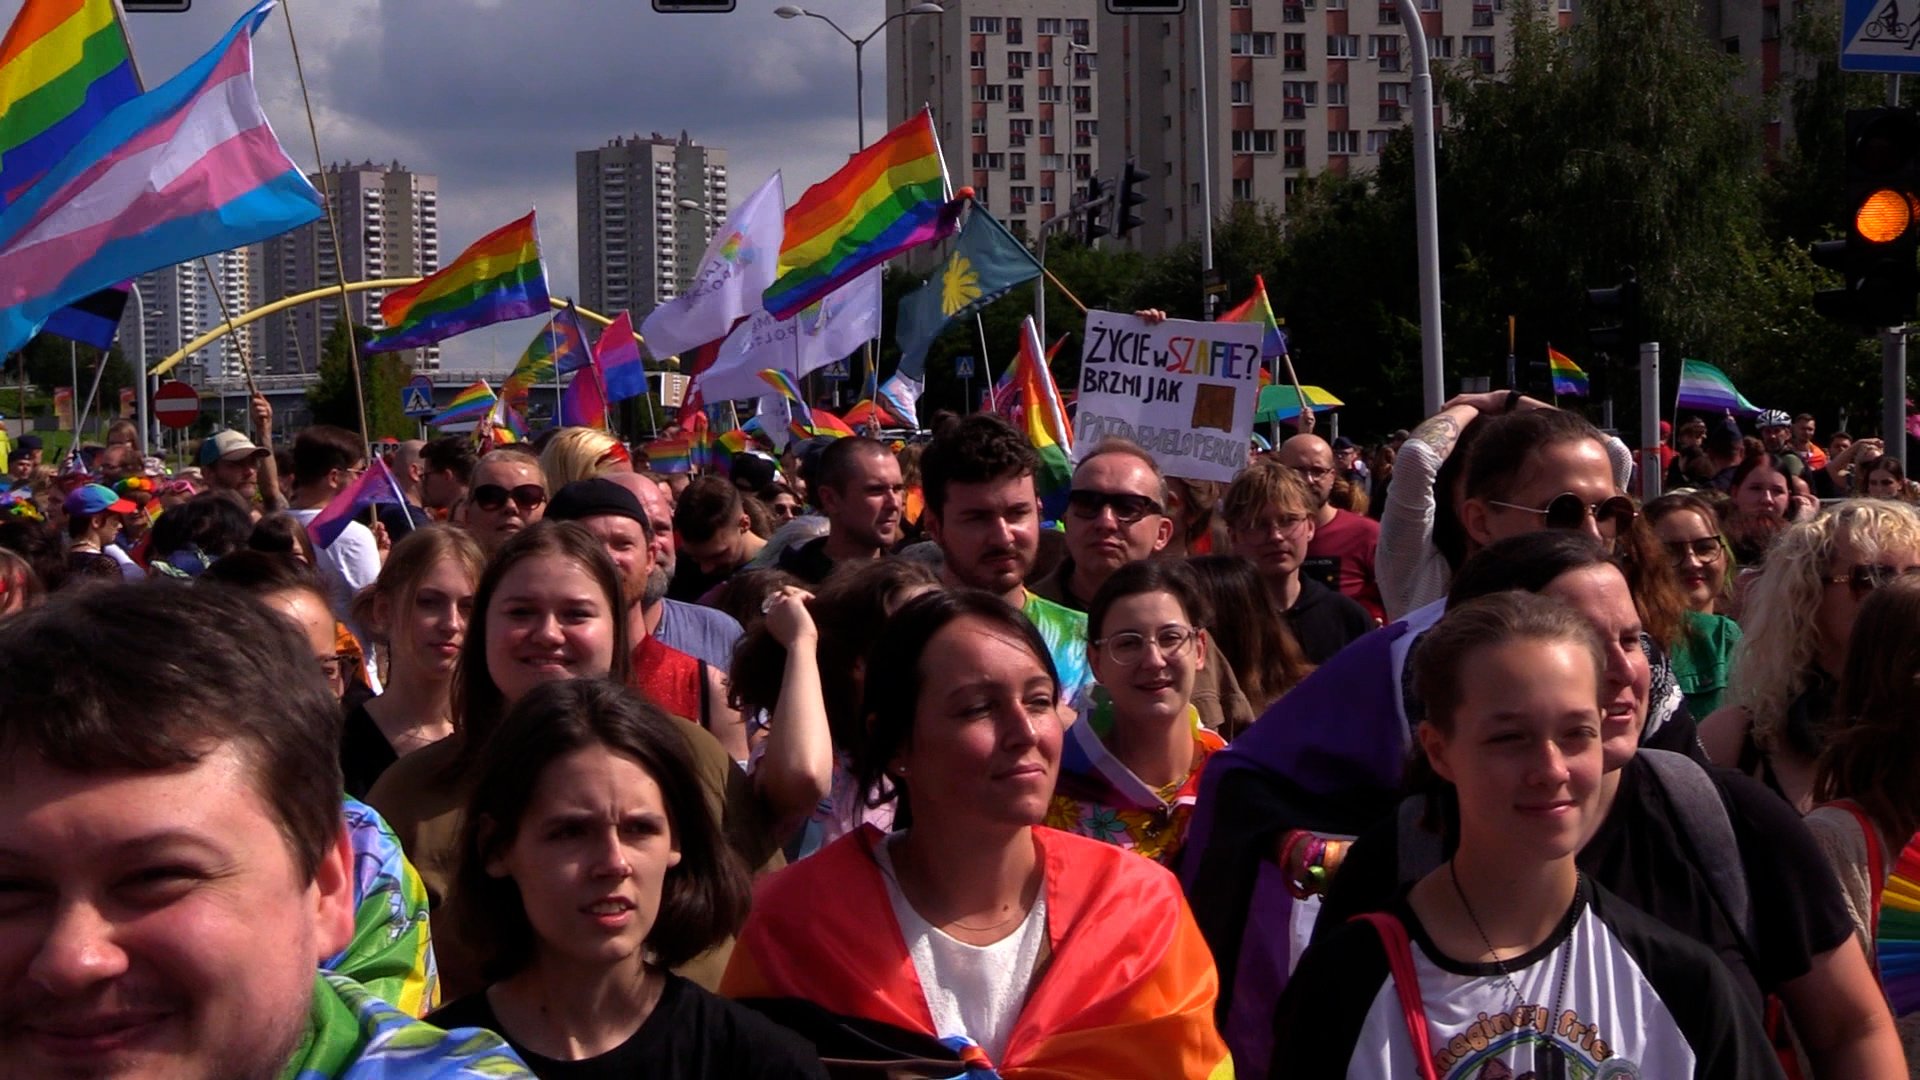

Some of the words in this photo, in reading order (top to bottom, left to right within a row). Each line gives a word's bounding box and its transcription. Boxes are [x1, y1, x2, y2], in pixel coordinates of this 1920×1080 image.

[1085, 321, 1152, 366] ŻYCIE
[1166, 336, 1260, 380] SZAFIE?
[1082, 367, 1142, 398] BRZMI
[1142, 376, 1184, 404] JAK
[1420, 1004, 1550, 1077] maginary
[1558, 1010, 1615, 1063] frie
